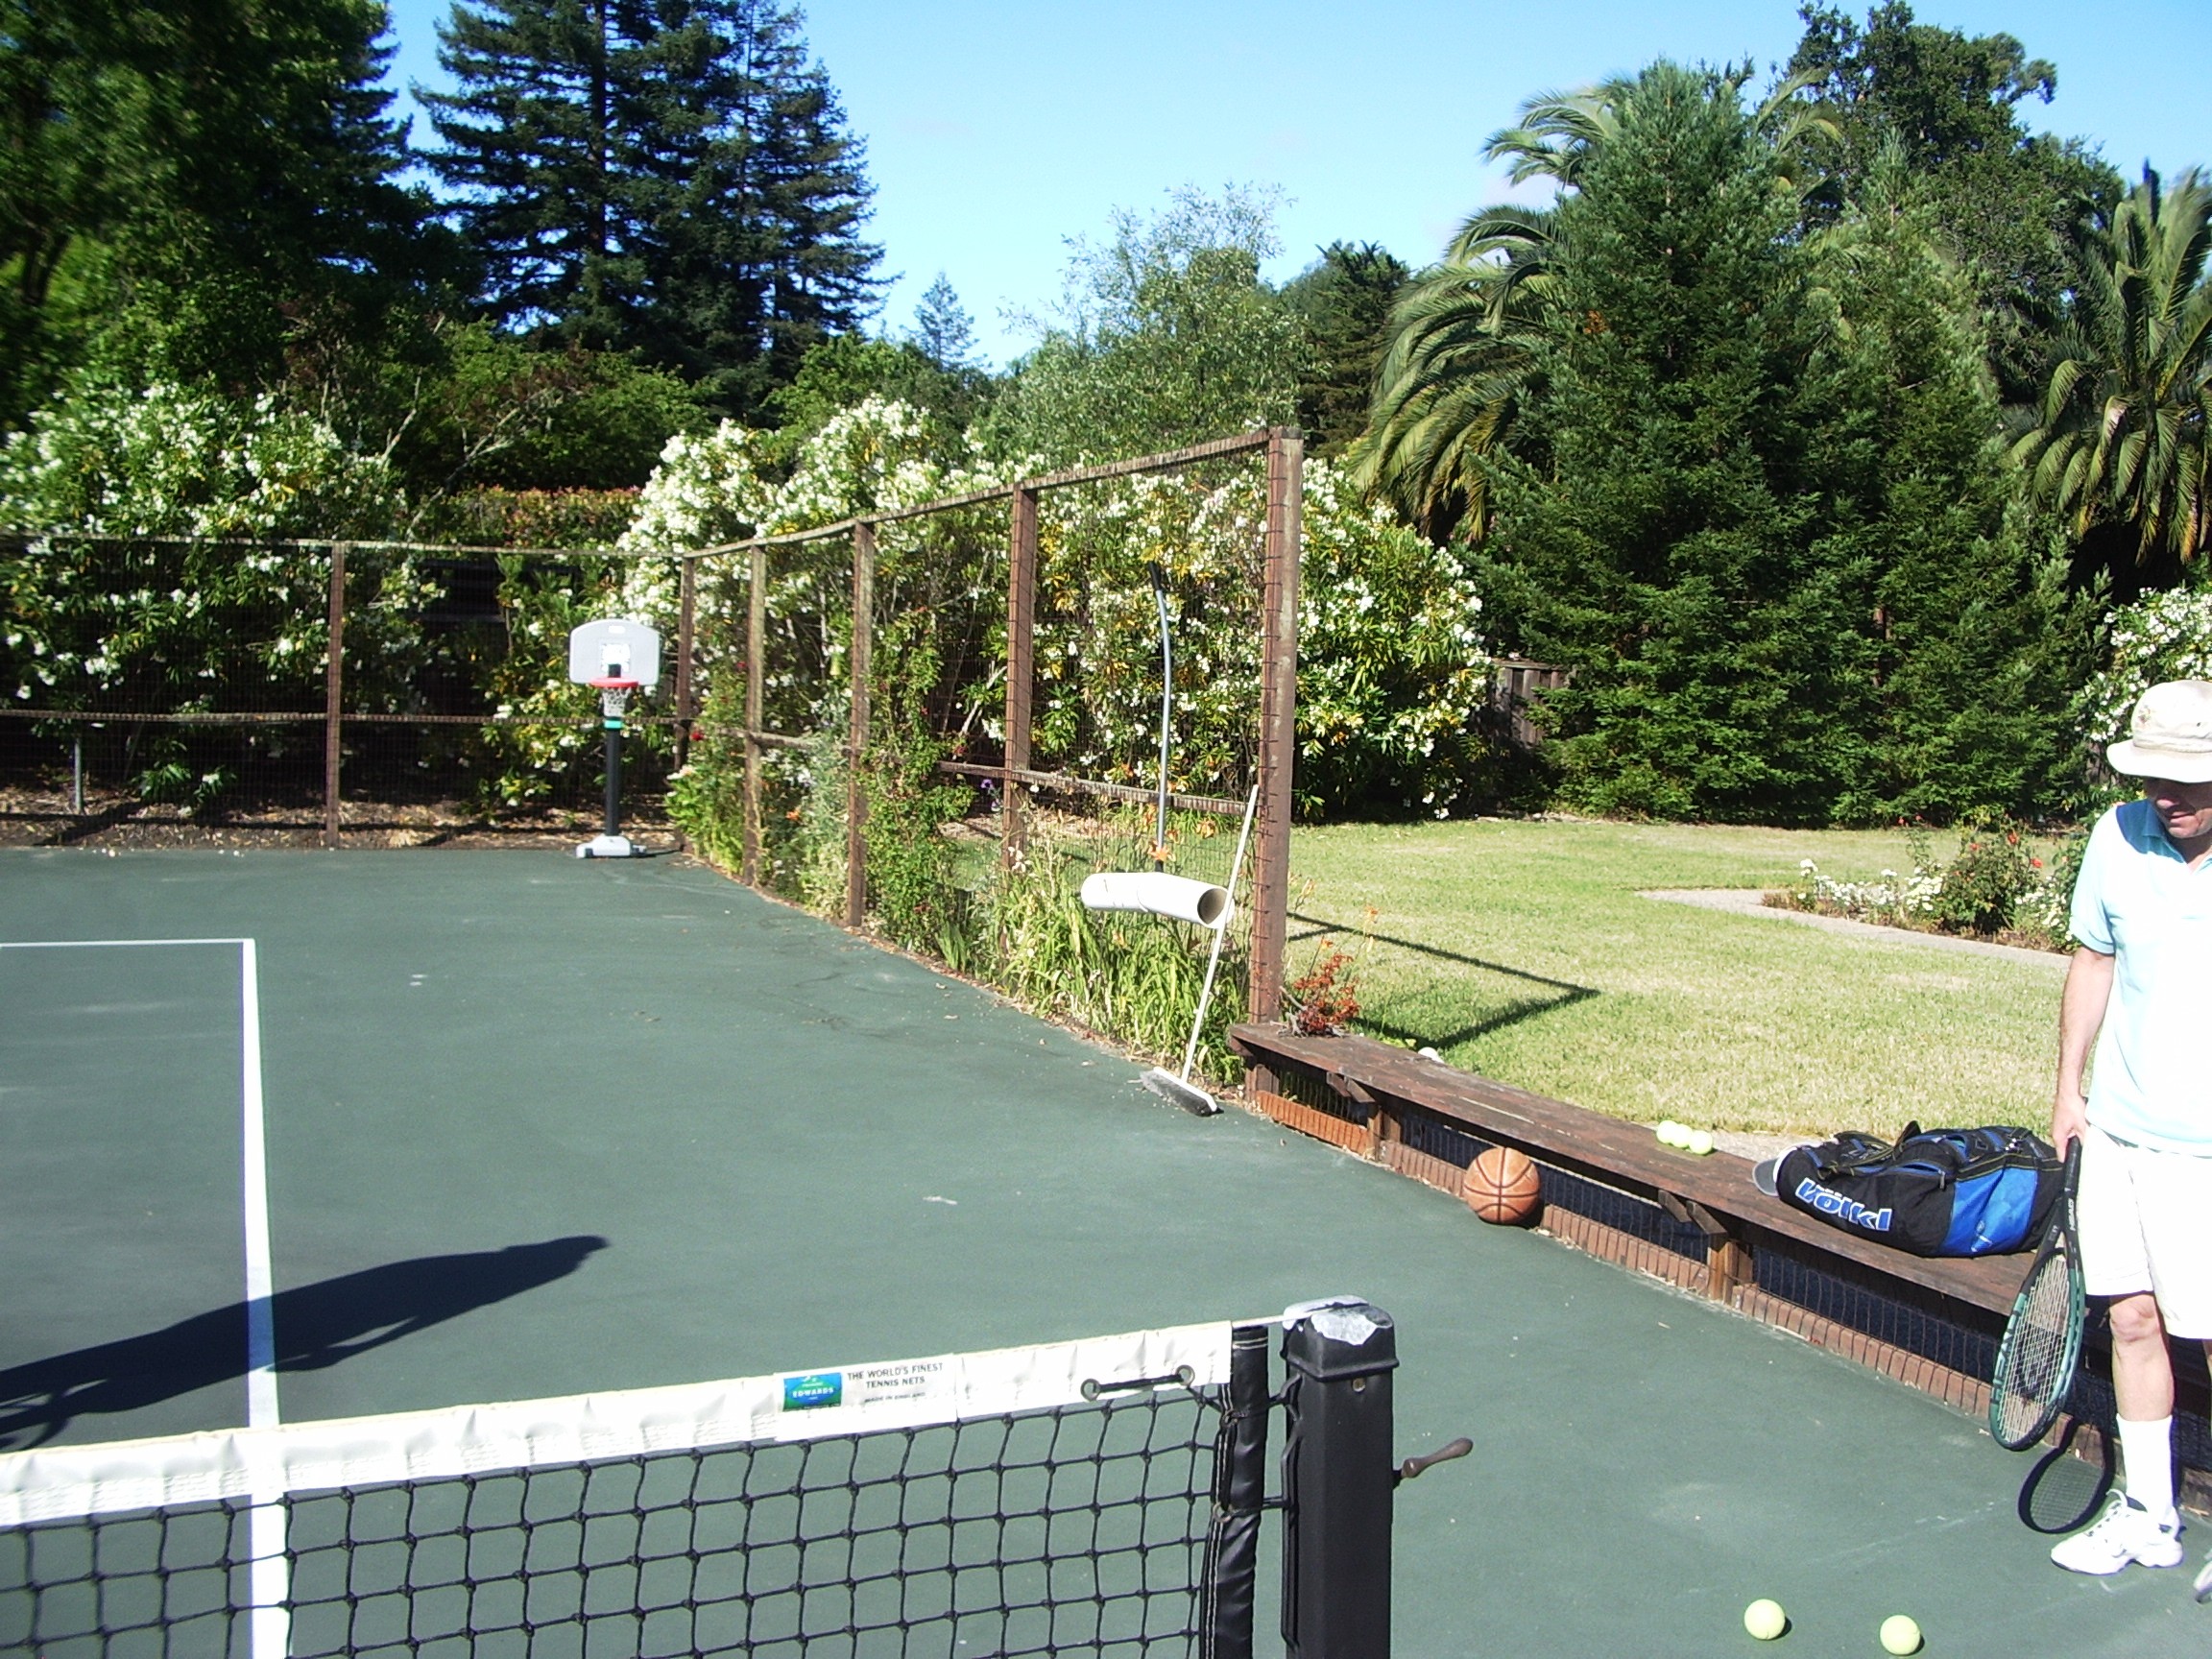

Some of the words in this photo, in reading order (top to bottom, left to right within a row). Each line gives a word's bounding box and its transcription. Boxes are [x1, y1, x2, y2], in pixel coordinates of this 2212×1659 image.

[847, 1371, 864, 1382] THE
[867, 1365, 908, 1379] WORLD'S
[912, 1362, 944, 1374] FINEST
[866, 1378, 899, 1389] TENNIS
[902, 1376, 926, 1385] NETS
[792, 1386, 833, 1398] EDWARDS
